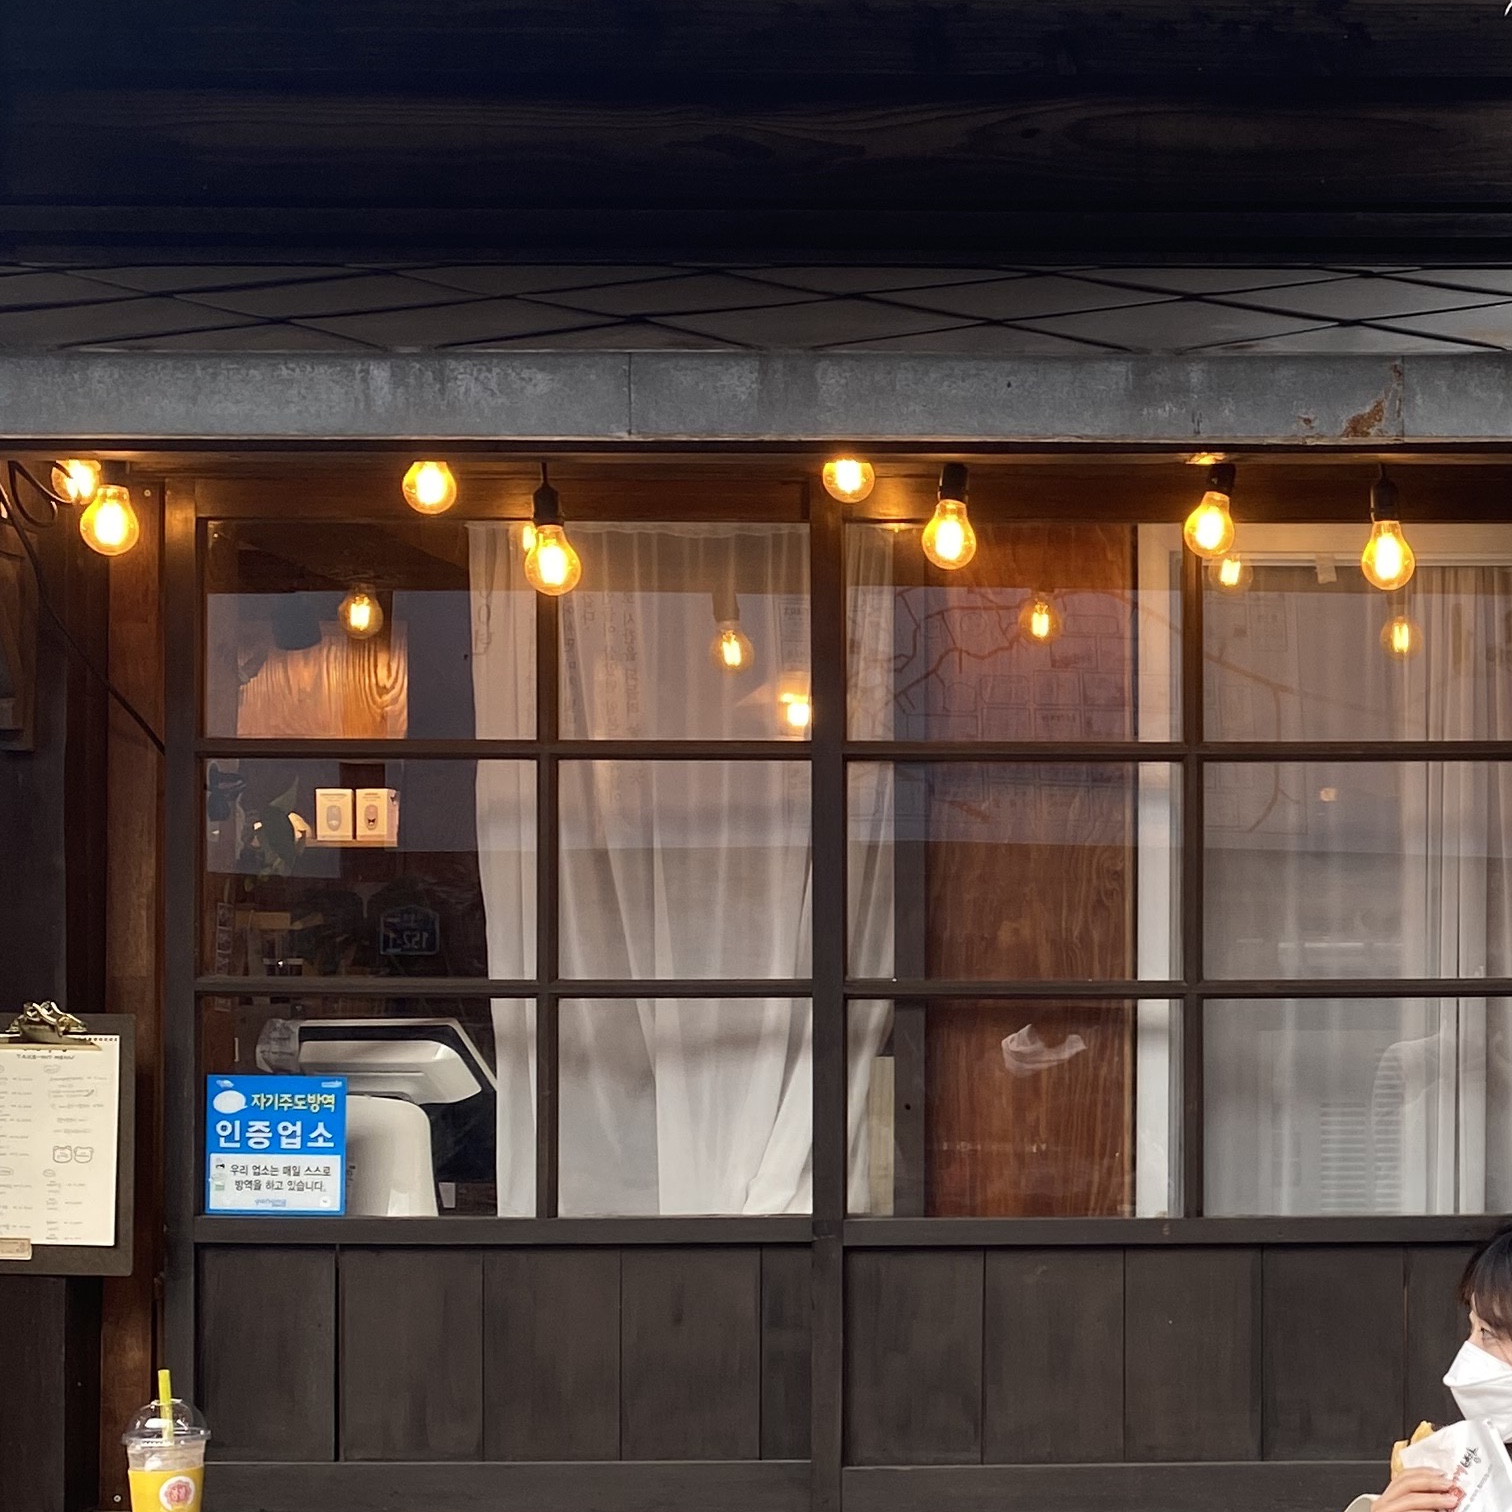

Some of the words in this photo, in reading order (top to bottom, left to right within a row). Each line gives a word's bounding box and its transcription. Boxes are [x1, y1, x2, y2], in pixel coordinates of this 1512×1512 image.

[251, 1093, 335, 1112] 자기주도방역
[215, 1120, 335, 1149] 인증업소
[230, 1164, 249, 1176] 우리
[252, 1164, 279, 1176] 업소는
[282, 1164, 300, 1176] 매일
[304, 1165, 331, 1176] 스스로
[235, 1179, 262, 1191] 방역을
[265, 1180, 283, 1191] 하고
